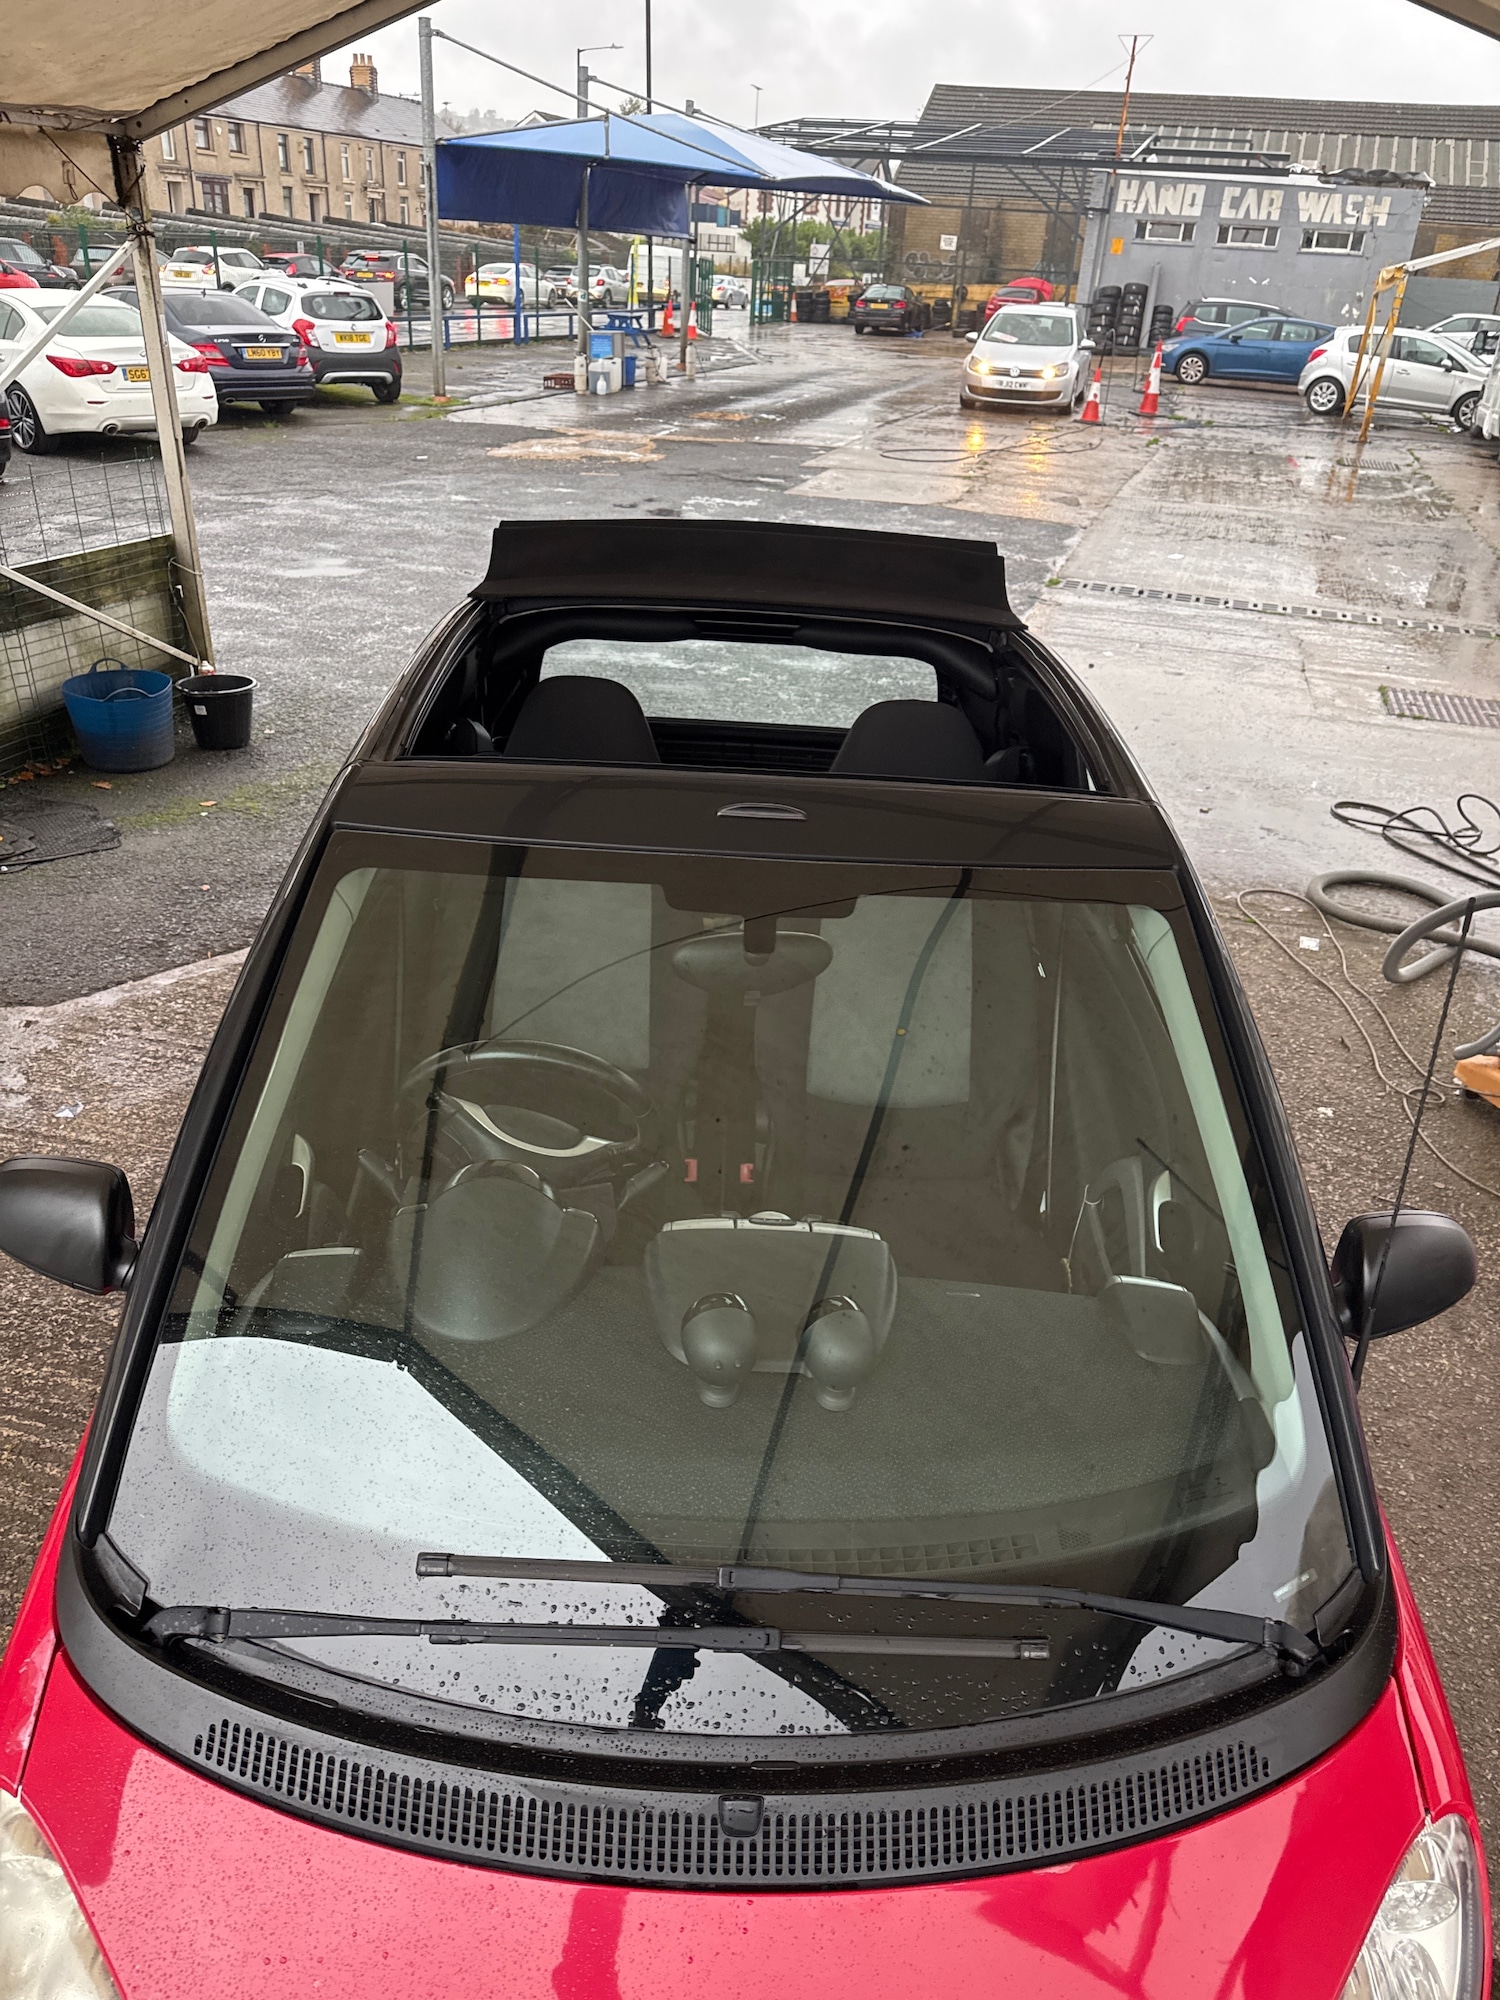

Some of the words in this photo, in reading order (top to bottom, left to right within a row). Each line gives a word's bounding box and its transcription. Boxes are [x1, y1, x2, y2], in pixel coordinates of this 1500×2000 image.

[1115, 179, 1206, 217] HAND
[1219, 185, 1284, 221] CAR
[1297, 190, 1392, 227] WASH
